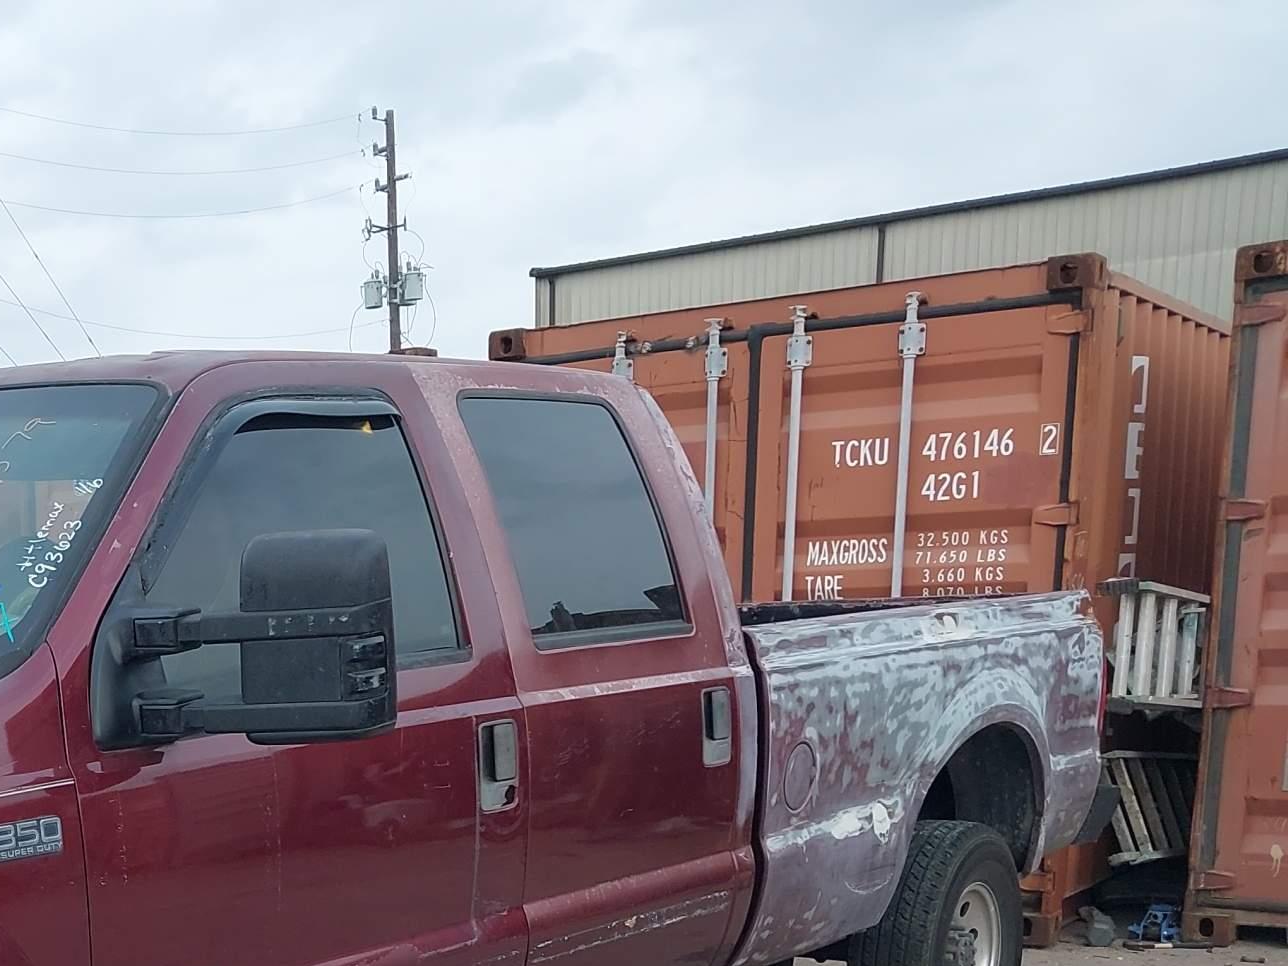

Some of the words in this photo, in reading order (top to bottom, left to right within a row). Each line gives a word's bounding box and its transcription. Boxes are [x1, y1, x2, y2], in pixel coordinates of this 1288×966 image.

[832, 438, 890, 468] TCKU
[922, 428, 1014, 461] 476146
[1042, 425, 1057, 453] 2
[921, 470, 981, 501] 42G1
[28, 520, 82, 588] C93623
[806, 538, 888, 567] MAXGROSS
[917, 531, 970, 547] 32.500
[979, 529, 1009, 545] KGS
[915, 550, 967, 565] 71.650
[977, 548, 1006, 563] LBS
[805, 575, 844, 601] TARE
[922, 568, 965, 583] 3.660
[975, 566, 1004, 582] KGS
[0, 847, 34, 859] SUPER
[37, 841, 63, 853] DUTY
